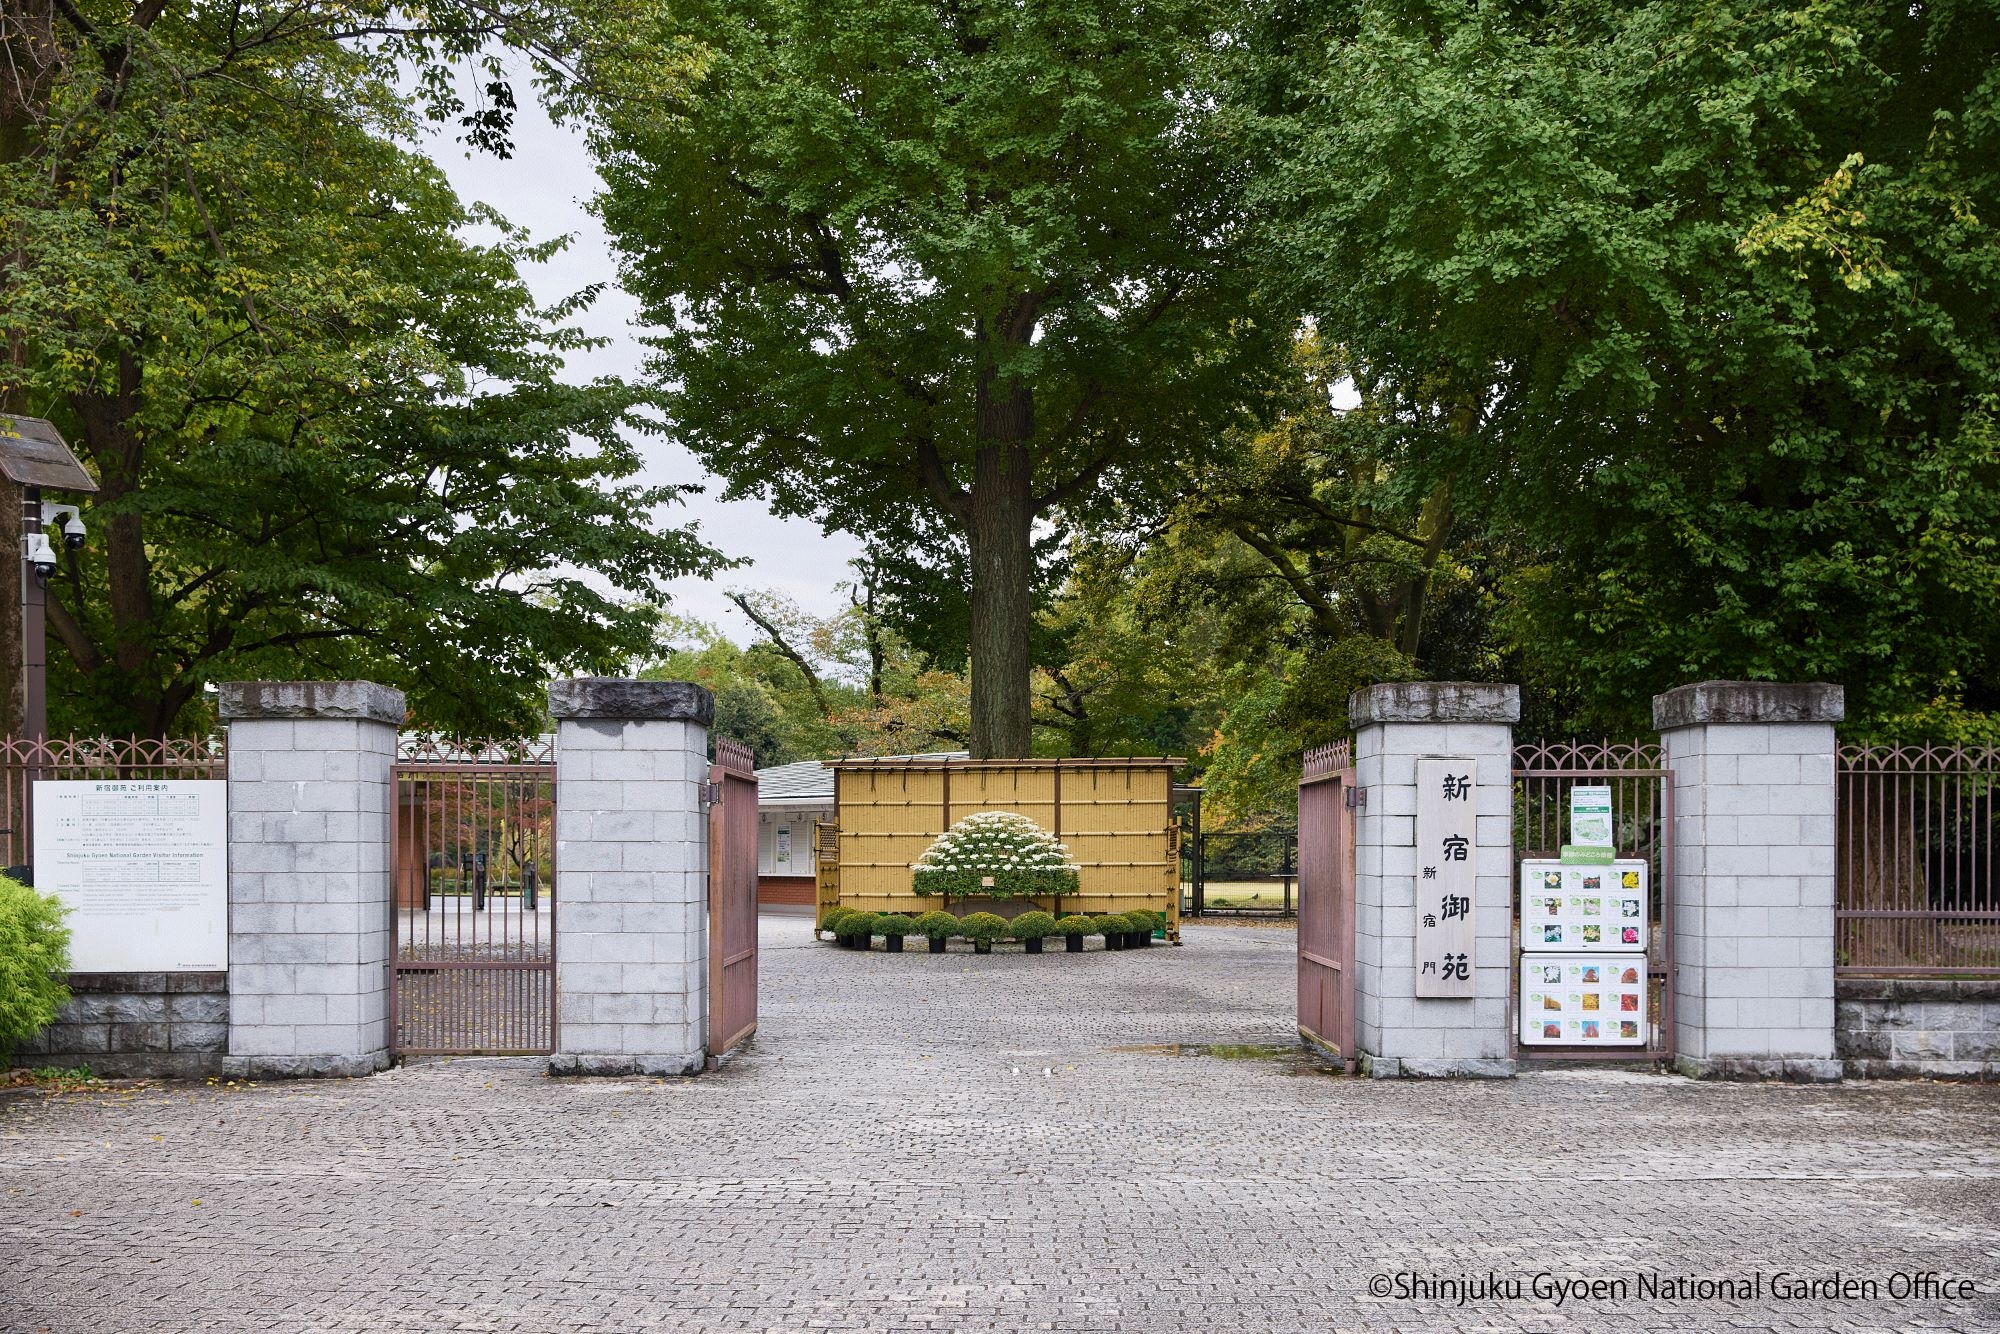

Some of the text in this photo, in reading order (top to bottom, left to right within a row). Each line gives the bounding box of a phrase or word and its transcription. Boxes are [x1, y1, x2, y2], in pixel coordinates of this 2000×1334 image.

[95, 784, 169, 792] 新宿御苑 ご利用案内
[1422, 866, 1437, 975] 新宿門
[1441, 774, 1472, 981] 新宿御苑
